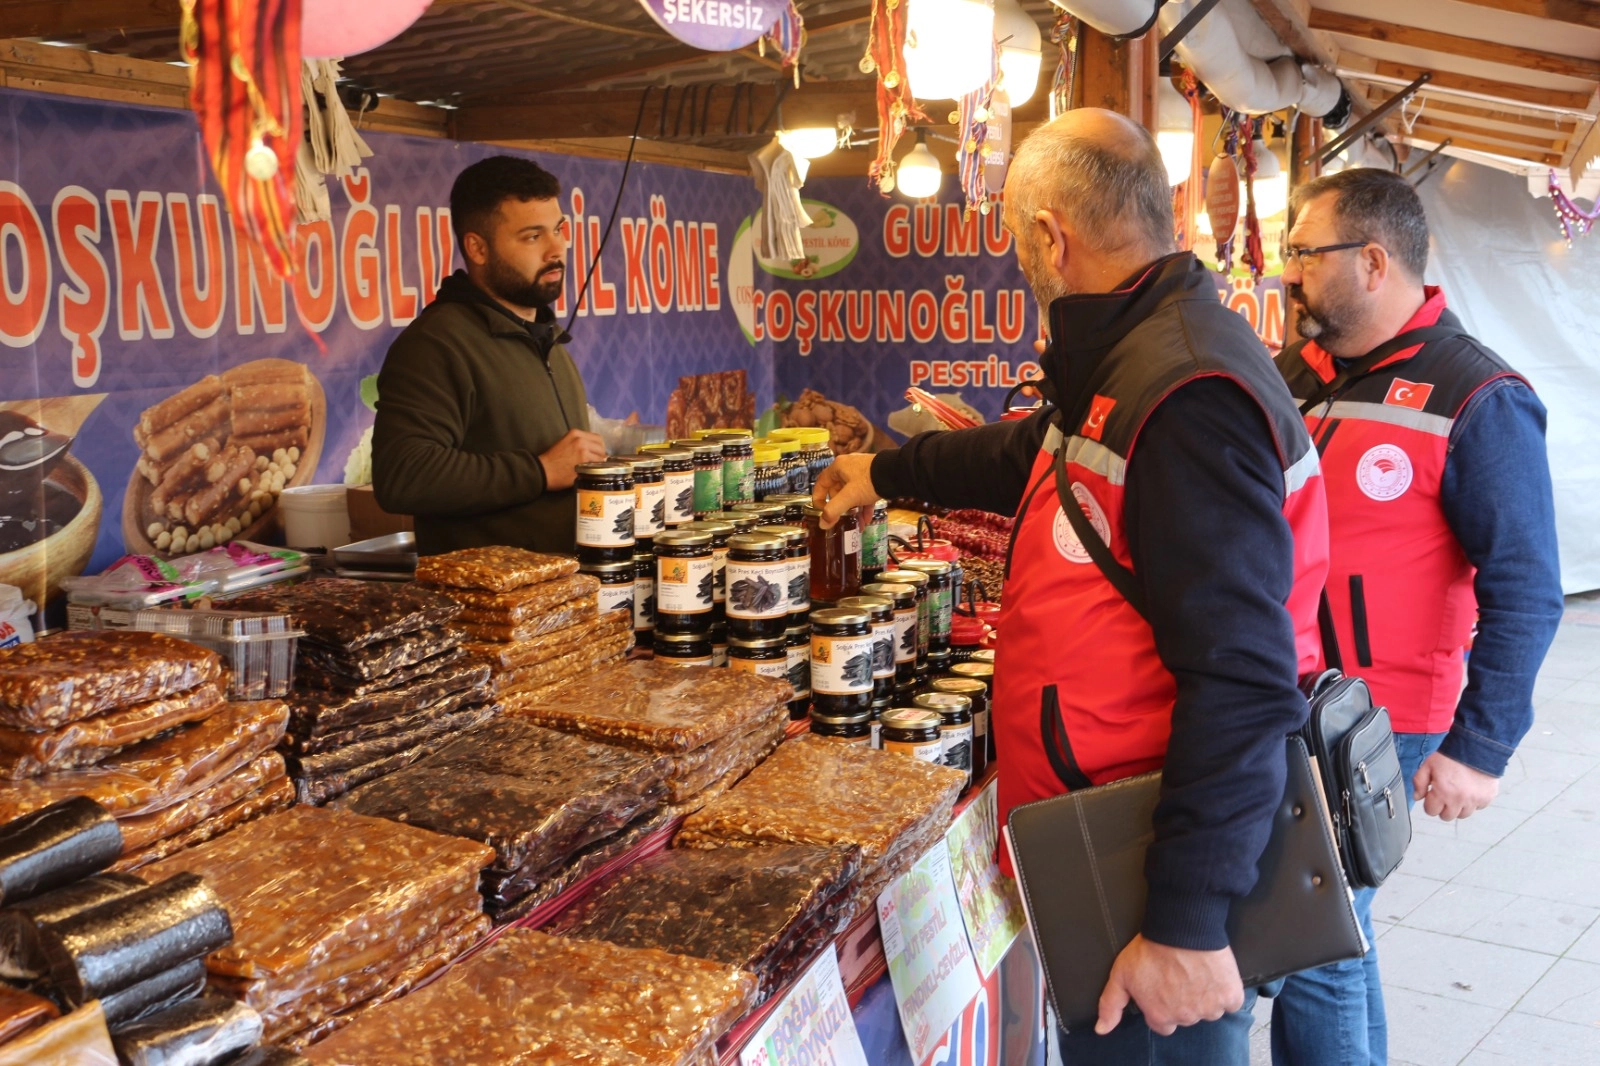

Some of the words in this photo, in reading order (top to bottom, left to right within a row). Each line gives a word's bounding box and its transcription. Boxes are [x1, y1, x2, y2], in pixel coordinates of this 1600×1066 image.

[663, 0, 764, 31] ŞEKERSİZ
[884, 193, 1017, 258] GÜMÜ
[0, 167, 453, 388] OŞKUNOĞLU
[621, 194, 721, 314] KÖME
[752, 275, 1025, 356] COŞKUNOĞLU
[910, 354, 1040, 388] PESTİLC
[771, 987, 818, 1059] DOĞAL
[788, 991, 847, 1066] OYNUZU
